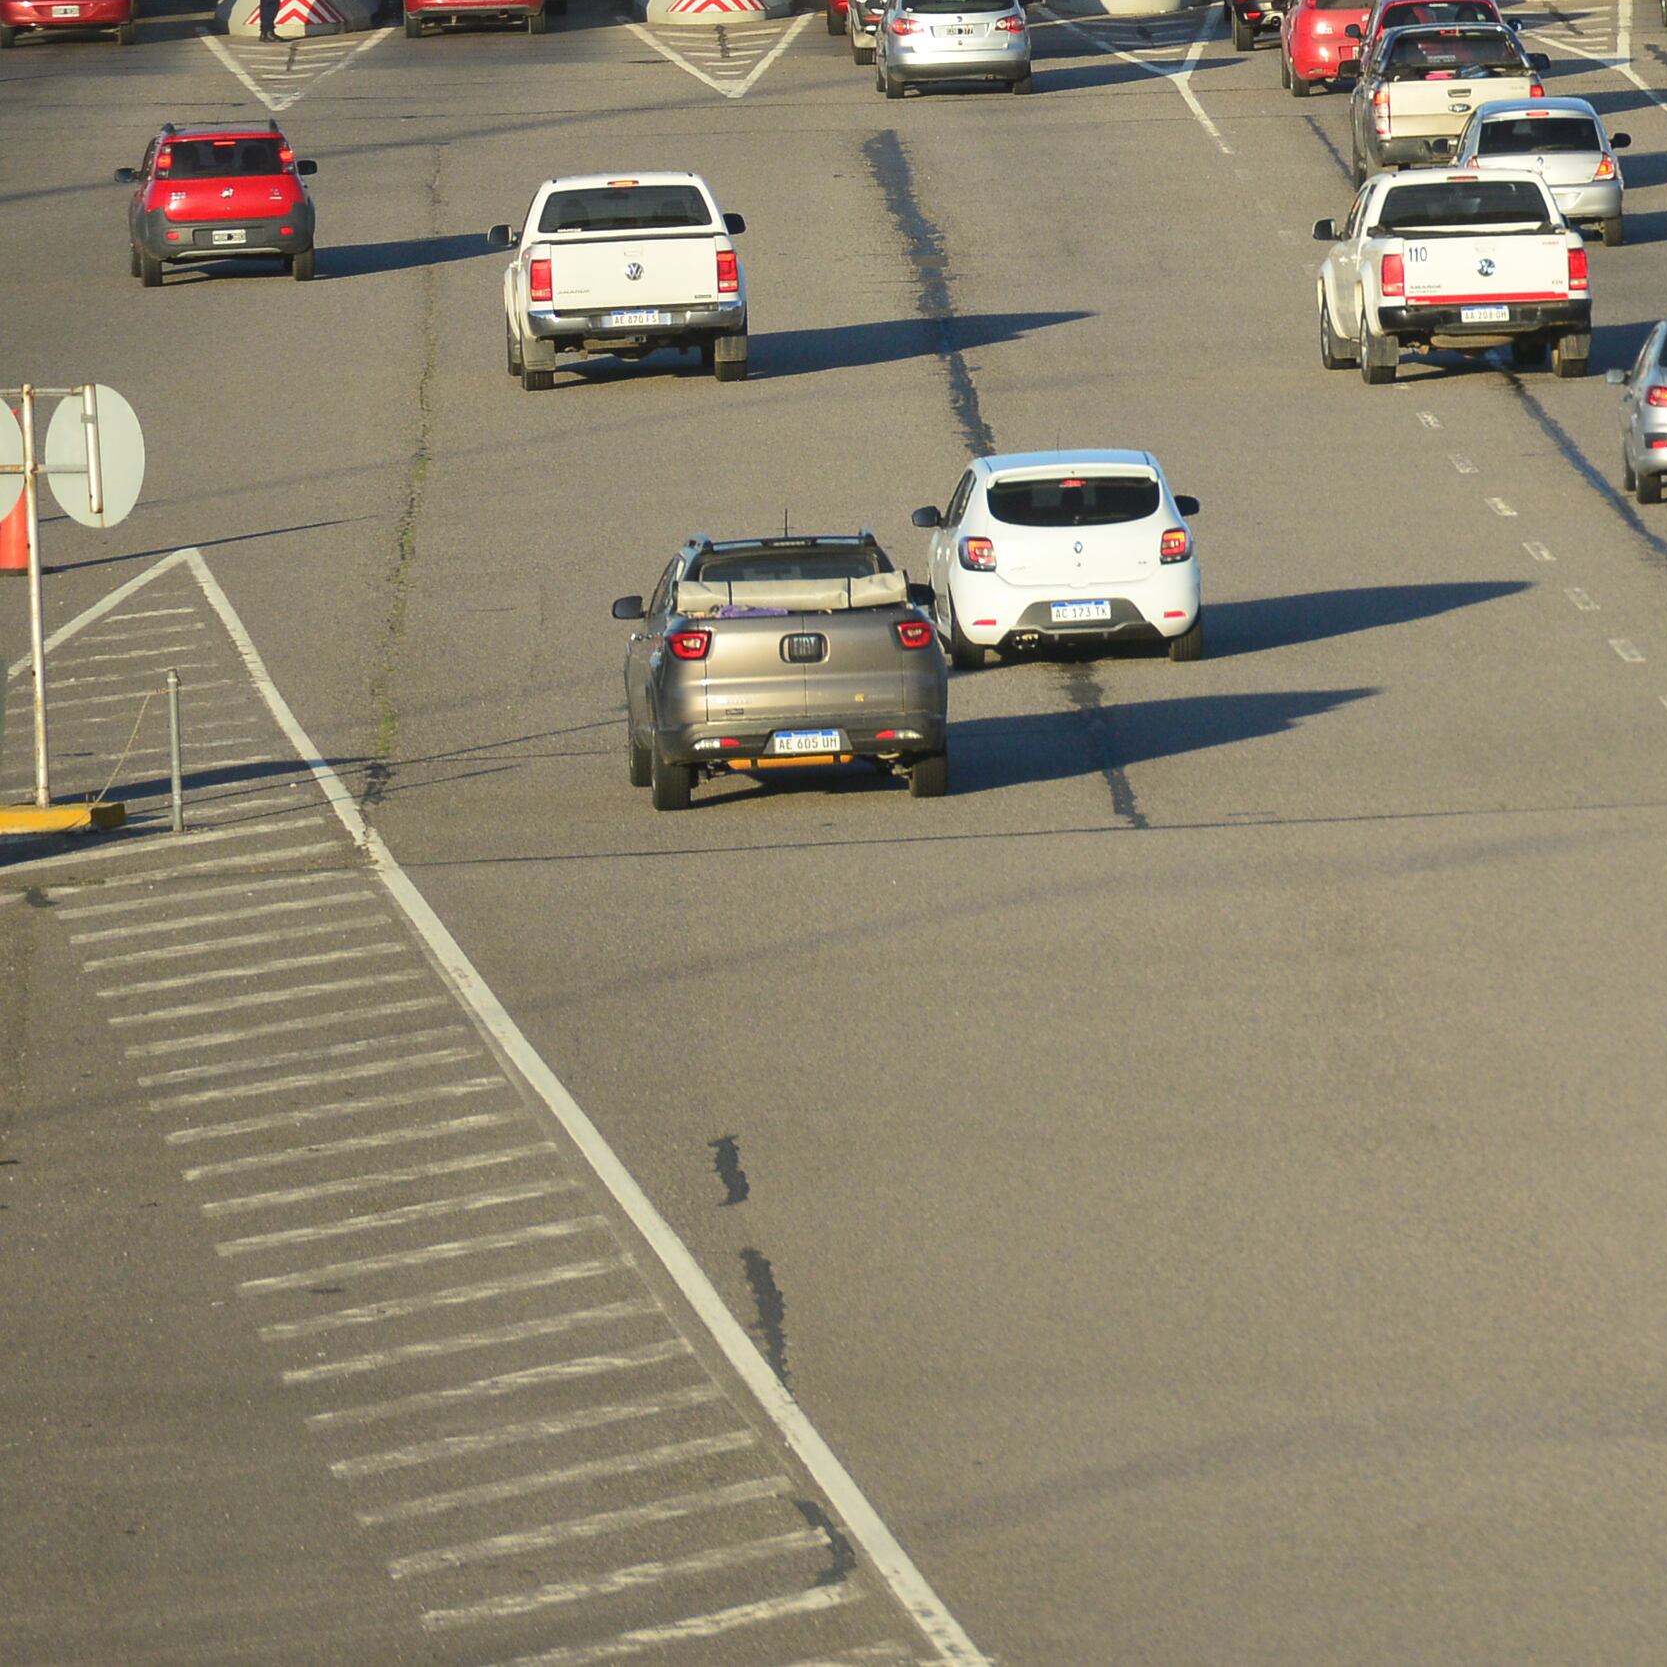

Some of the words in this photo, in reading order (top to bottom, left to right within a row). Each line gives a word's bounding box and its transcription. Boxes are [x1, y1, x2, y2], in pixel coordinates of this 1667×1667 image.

[1408, 246, 1428, 262] 110
[614, 316, 625, 325] AE
[628, 315, 643, 324] 870
[646, 315, 657, 323] FS
[1055, 607, 1068, 619] AC
[1072, 606, 1091, 618] 173
[1095, 605, 1107, 616] TK
[778, 738, 792, 750] AE
[797, 737, 819, 749] 605
